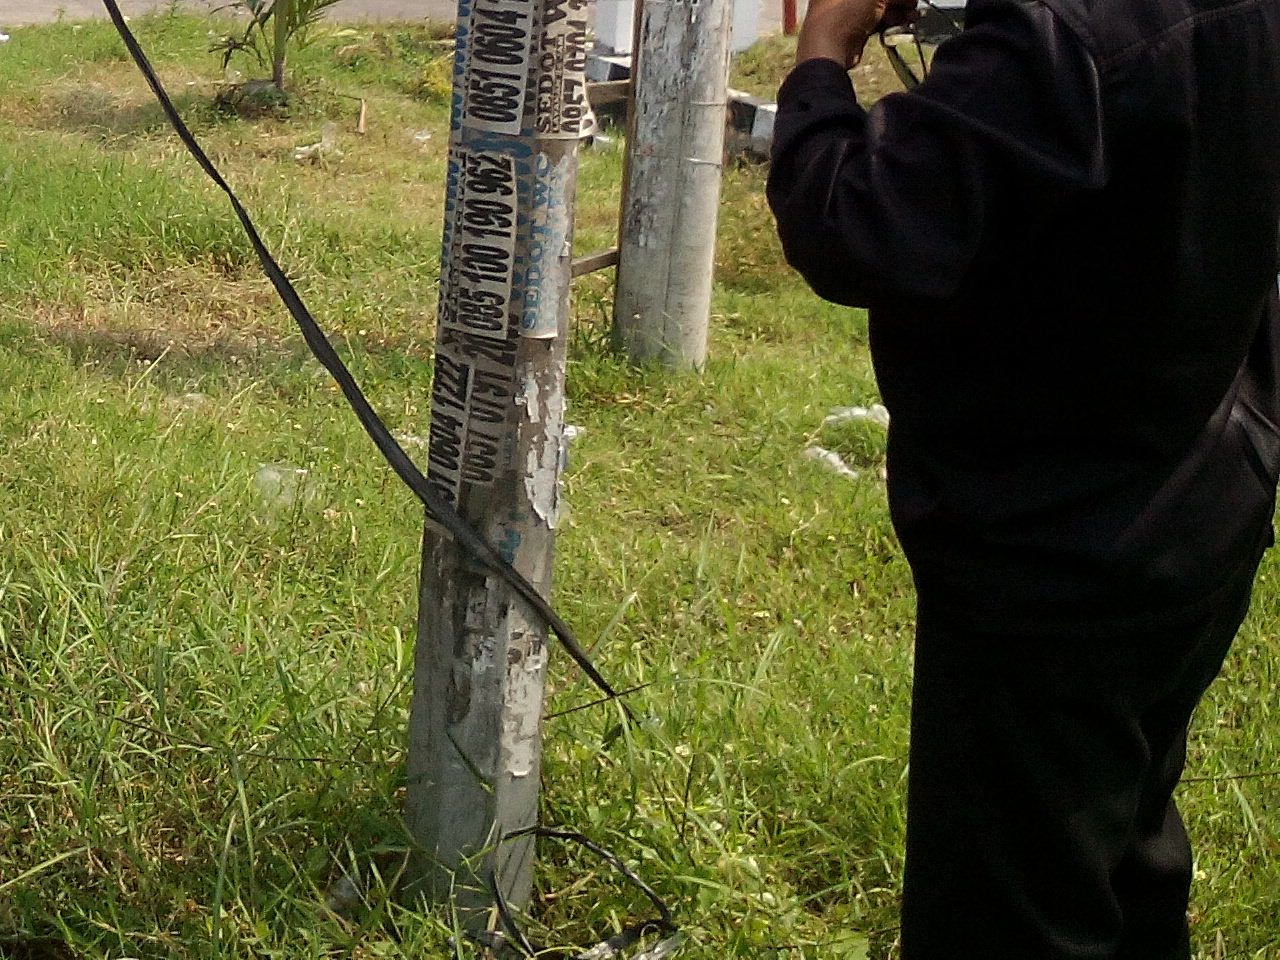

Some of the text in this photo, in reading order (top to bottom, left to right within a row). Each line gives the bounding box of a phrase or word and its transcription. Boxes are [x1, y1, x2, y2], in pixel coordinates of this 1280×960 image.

[472, 9, 528, 65] 0604
[467, 68, 521, 123] 0851
[535, 31, 556, 133] SEDOT
[466, 153, 514, 196] 962
[463, 199, 513, 239] 190
[461, 244, 510, 283] 100
[521, 218, 546, 330] SEDOT
